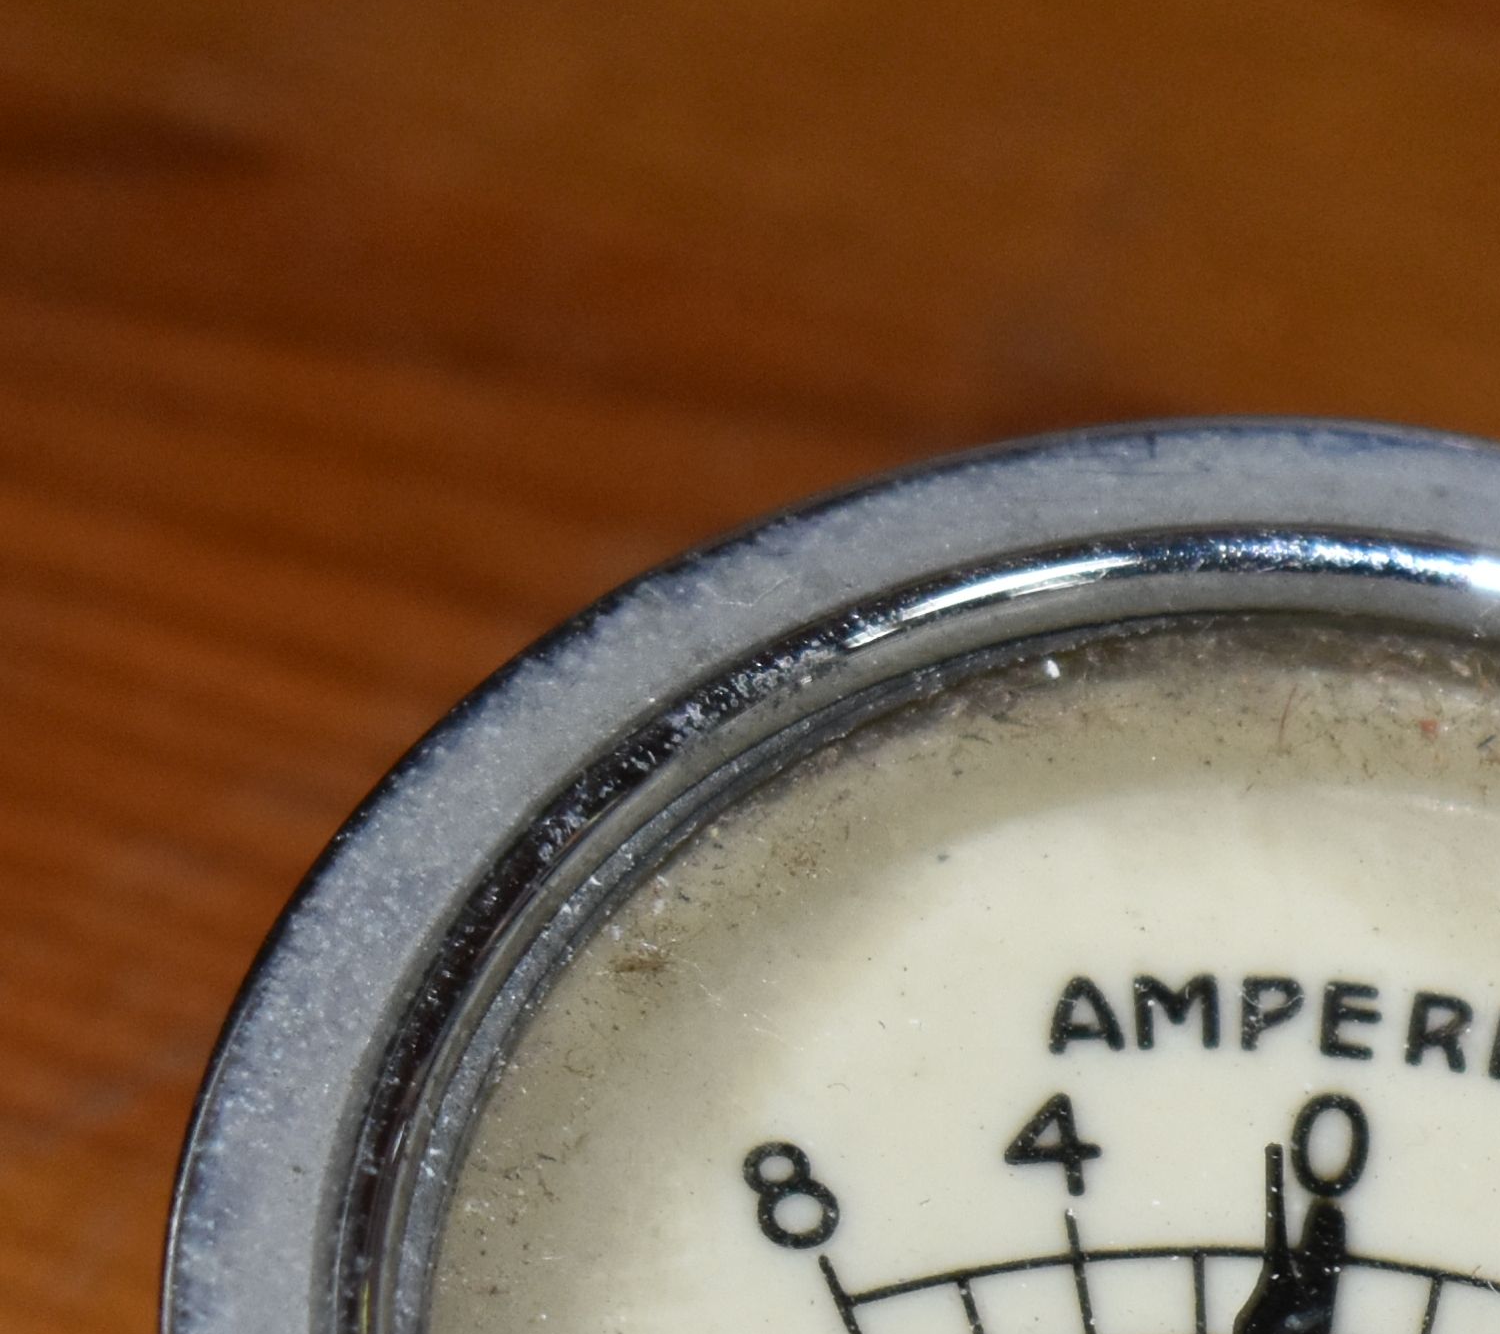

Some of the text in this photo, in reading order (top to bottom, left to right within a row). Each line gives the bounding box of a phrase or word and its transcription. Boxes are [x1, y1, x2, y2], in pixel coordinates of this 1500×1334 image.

[742, 1141, 841, 1250] 8
[1004, 1092, 1101, 1196] 4
[1289, 1092, 1370, 1198] 0
